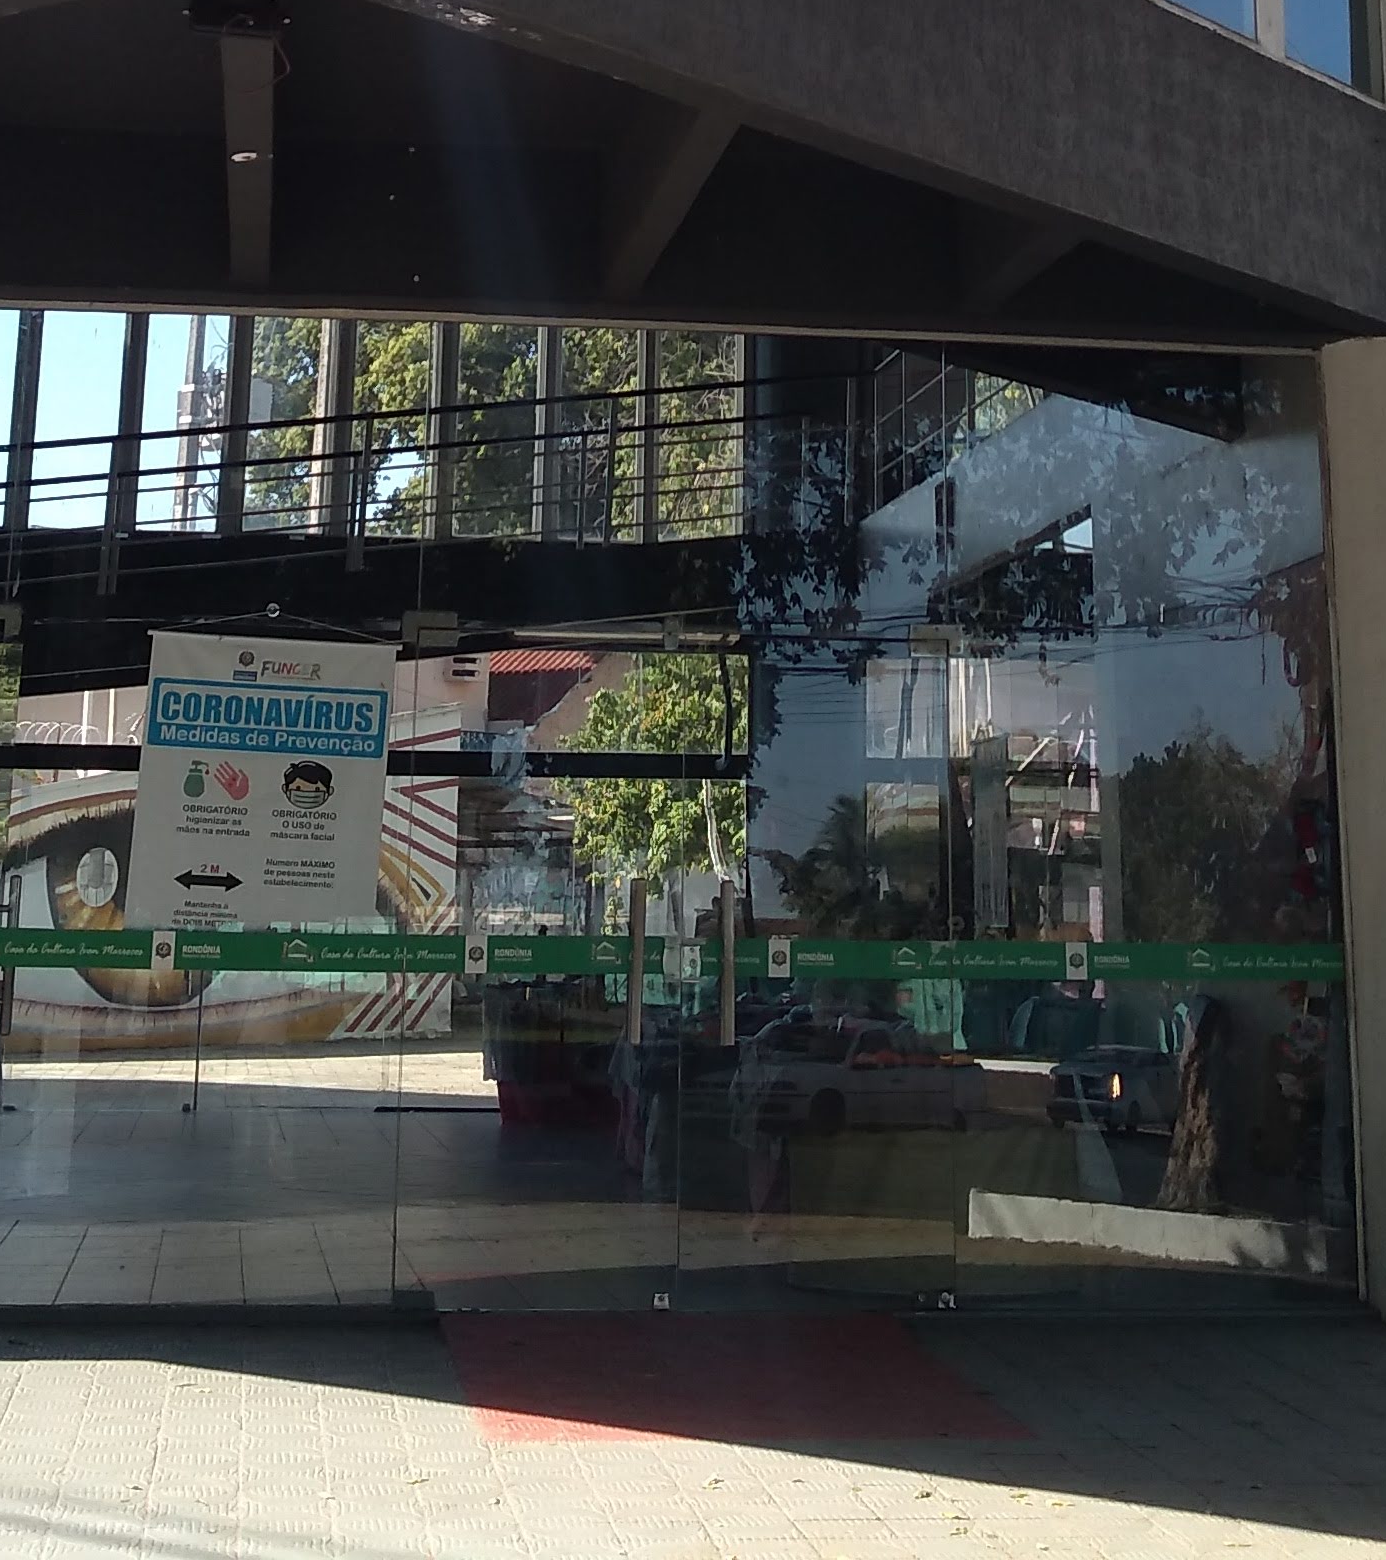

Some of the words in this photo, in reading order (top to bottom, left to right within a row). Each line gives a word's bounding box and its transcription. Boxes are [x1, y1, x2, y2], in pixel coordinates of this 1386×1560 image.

[161, 691, 373, 732] CORONAVÍRUS
[160, 725, 241, 745] Medidas
[245, 730, 269, 746] de
[275, 731, 375, 755] Prevenção
[182, 804, 248, 816] OBRIGATÓRIO
[272, 809, 338, 821] OBRIGATÓRIO
[186, 815, 230, 825] higienizar
[232, 818, 242, 826] as
[282, 820, 290, 829] O
[291, 821, 312, 830] USO
[313, 822, 325, 831] de
[176, 825, 200, 834] mãos
[202, 827, 214, 835] na
[215, 827, 251, 837] entrada
[270, 830, 309, 840] máscara
[310, 832, 335, 841] facial
[200, 864, 208, 873] 2
[210, 864, 220, 874] M
[264, 867, 275, 876] de
[276, 869, 311, 877] pessoas
[184, 900, 222, 910] Mantenha
[4, 941, 24, 954] Casa
[182, 943, 221, 954] RONDÔNIA
[320, 947, 340, 959] Casa
[494, 948, 532, 958] RONDÔNIA
